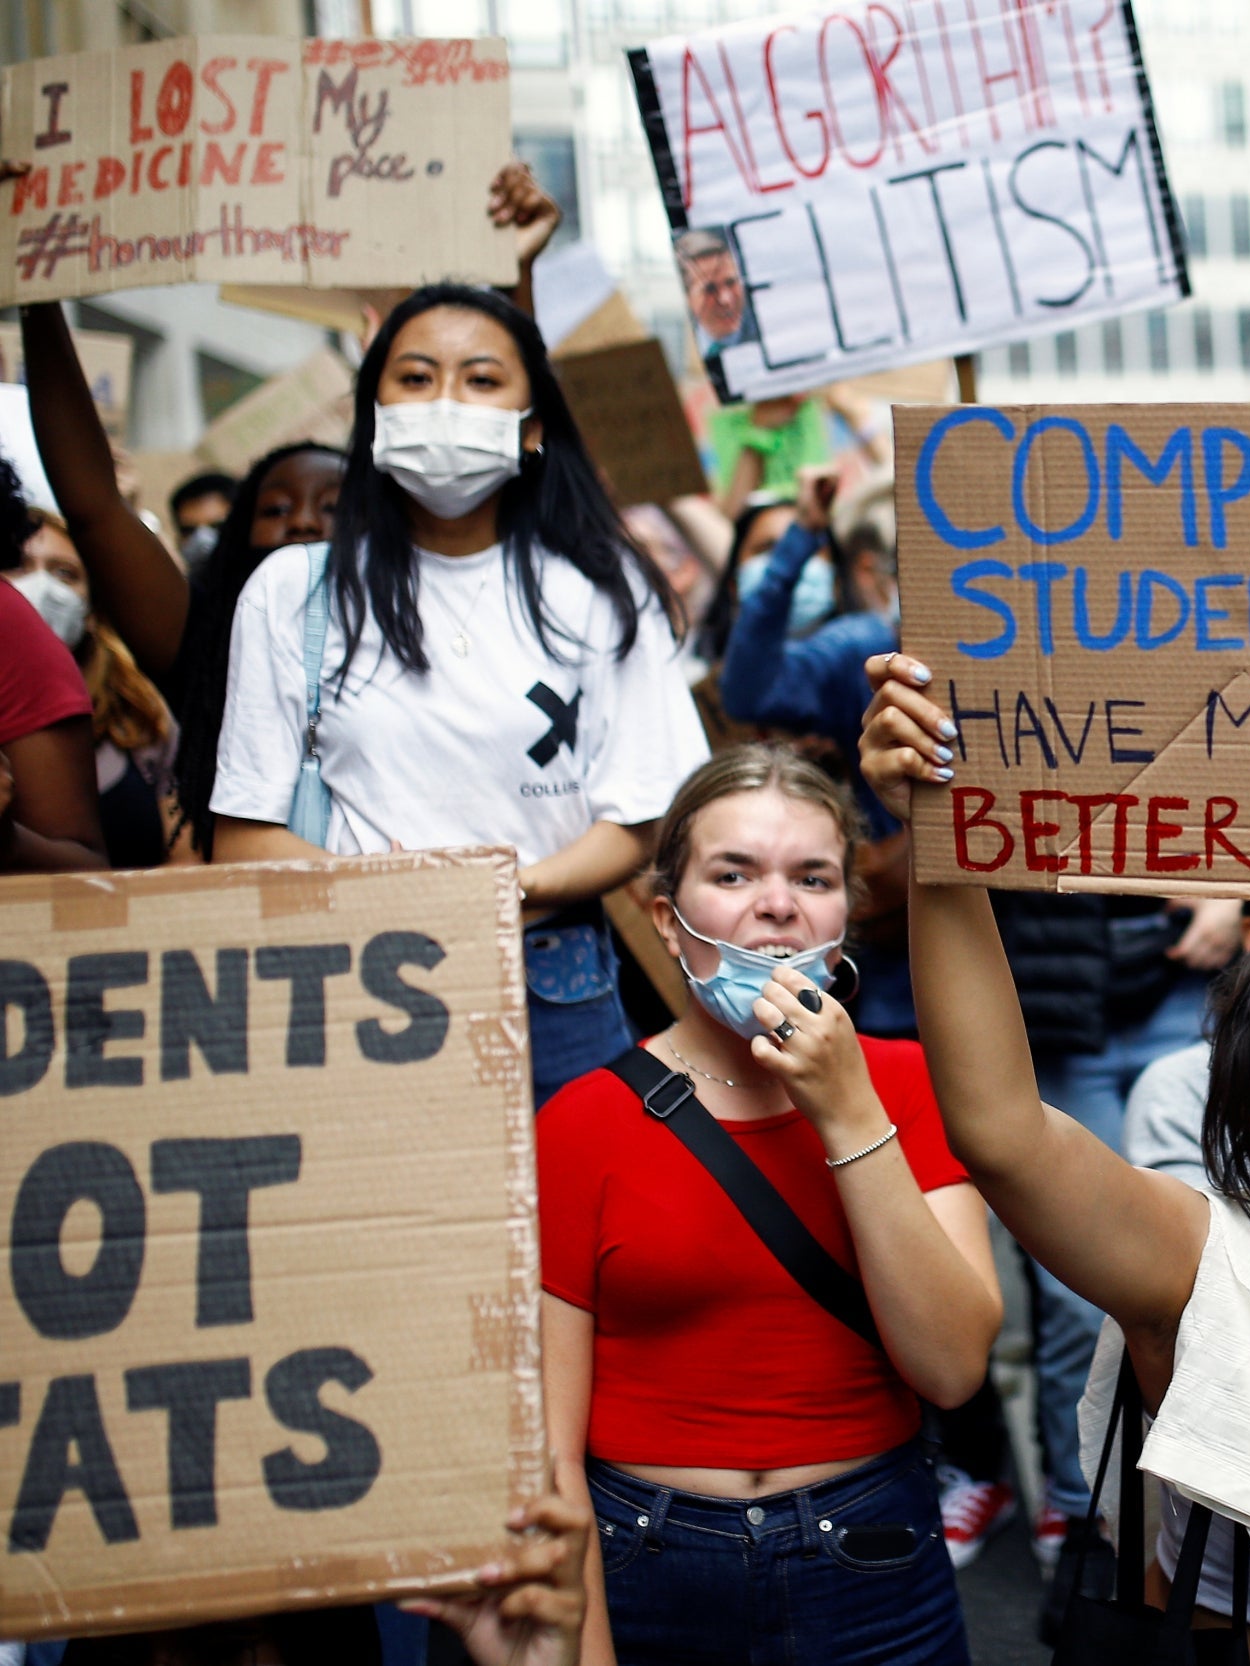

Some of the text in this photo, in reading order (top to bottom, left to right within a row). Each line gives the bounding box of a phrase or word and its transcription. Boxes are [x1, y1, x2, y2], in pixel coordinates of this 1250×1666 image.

[35, 82, 72, 149] I
[129, 59, 289, 144] LOST
[10, 142, 286, 215] MEDICINE
[731, 128, 1181, 369] ELITISM
[949, 679, 1156, 770] HAVE
[0, 1346, 384, 1555] ATS
